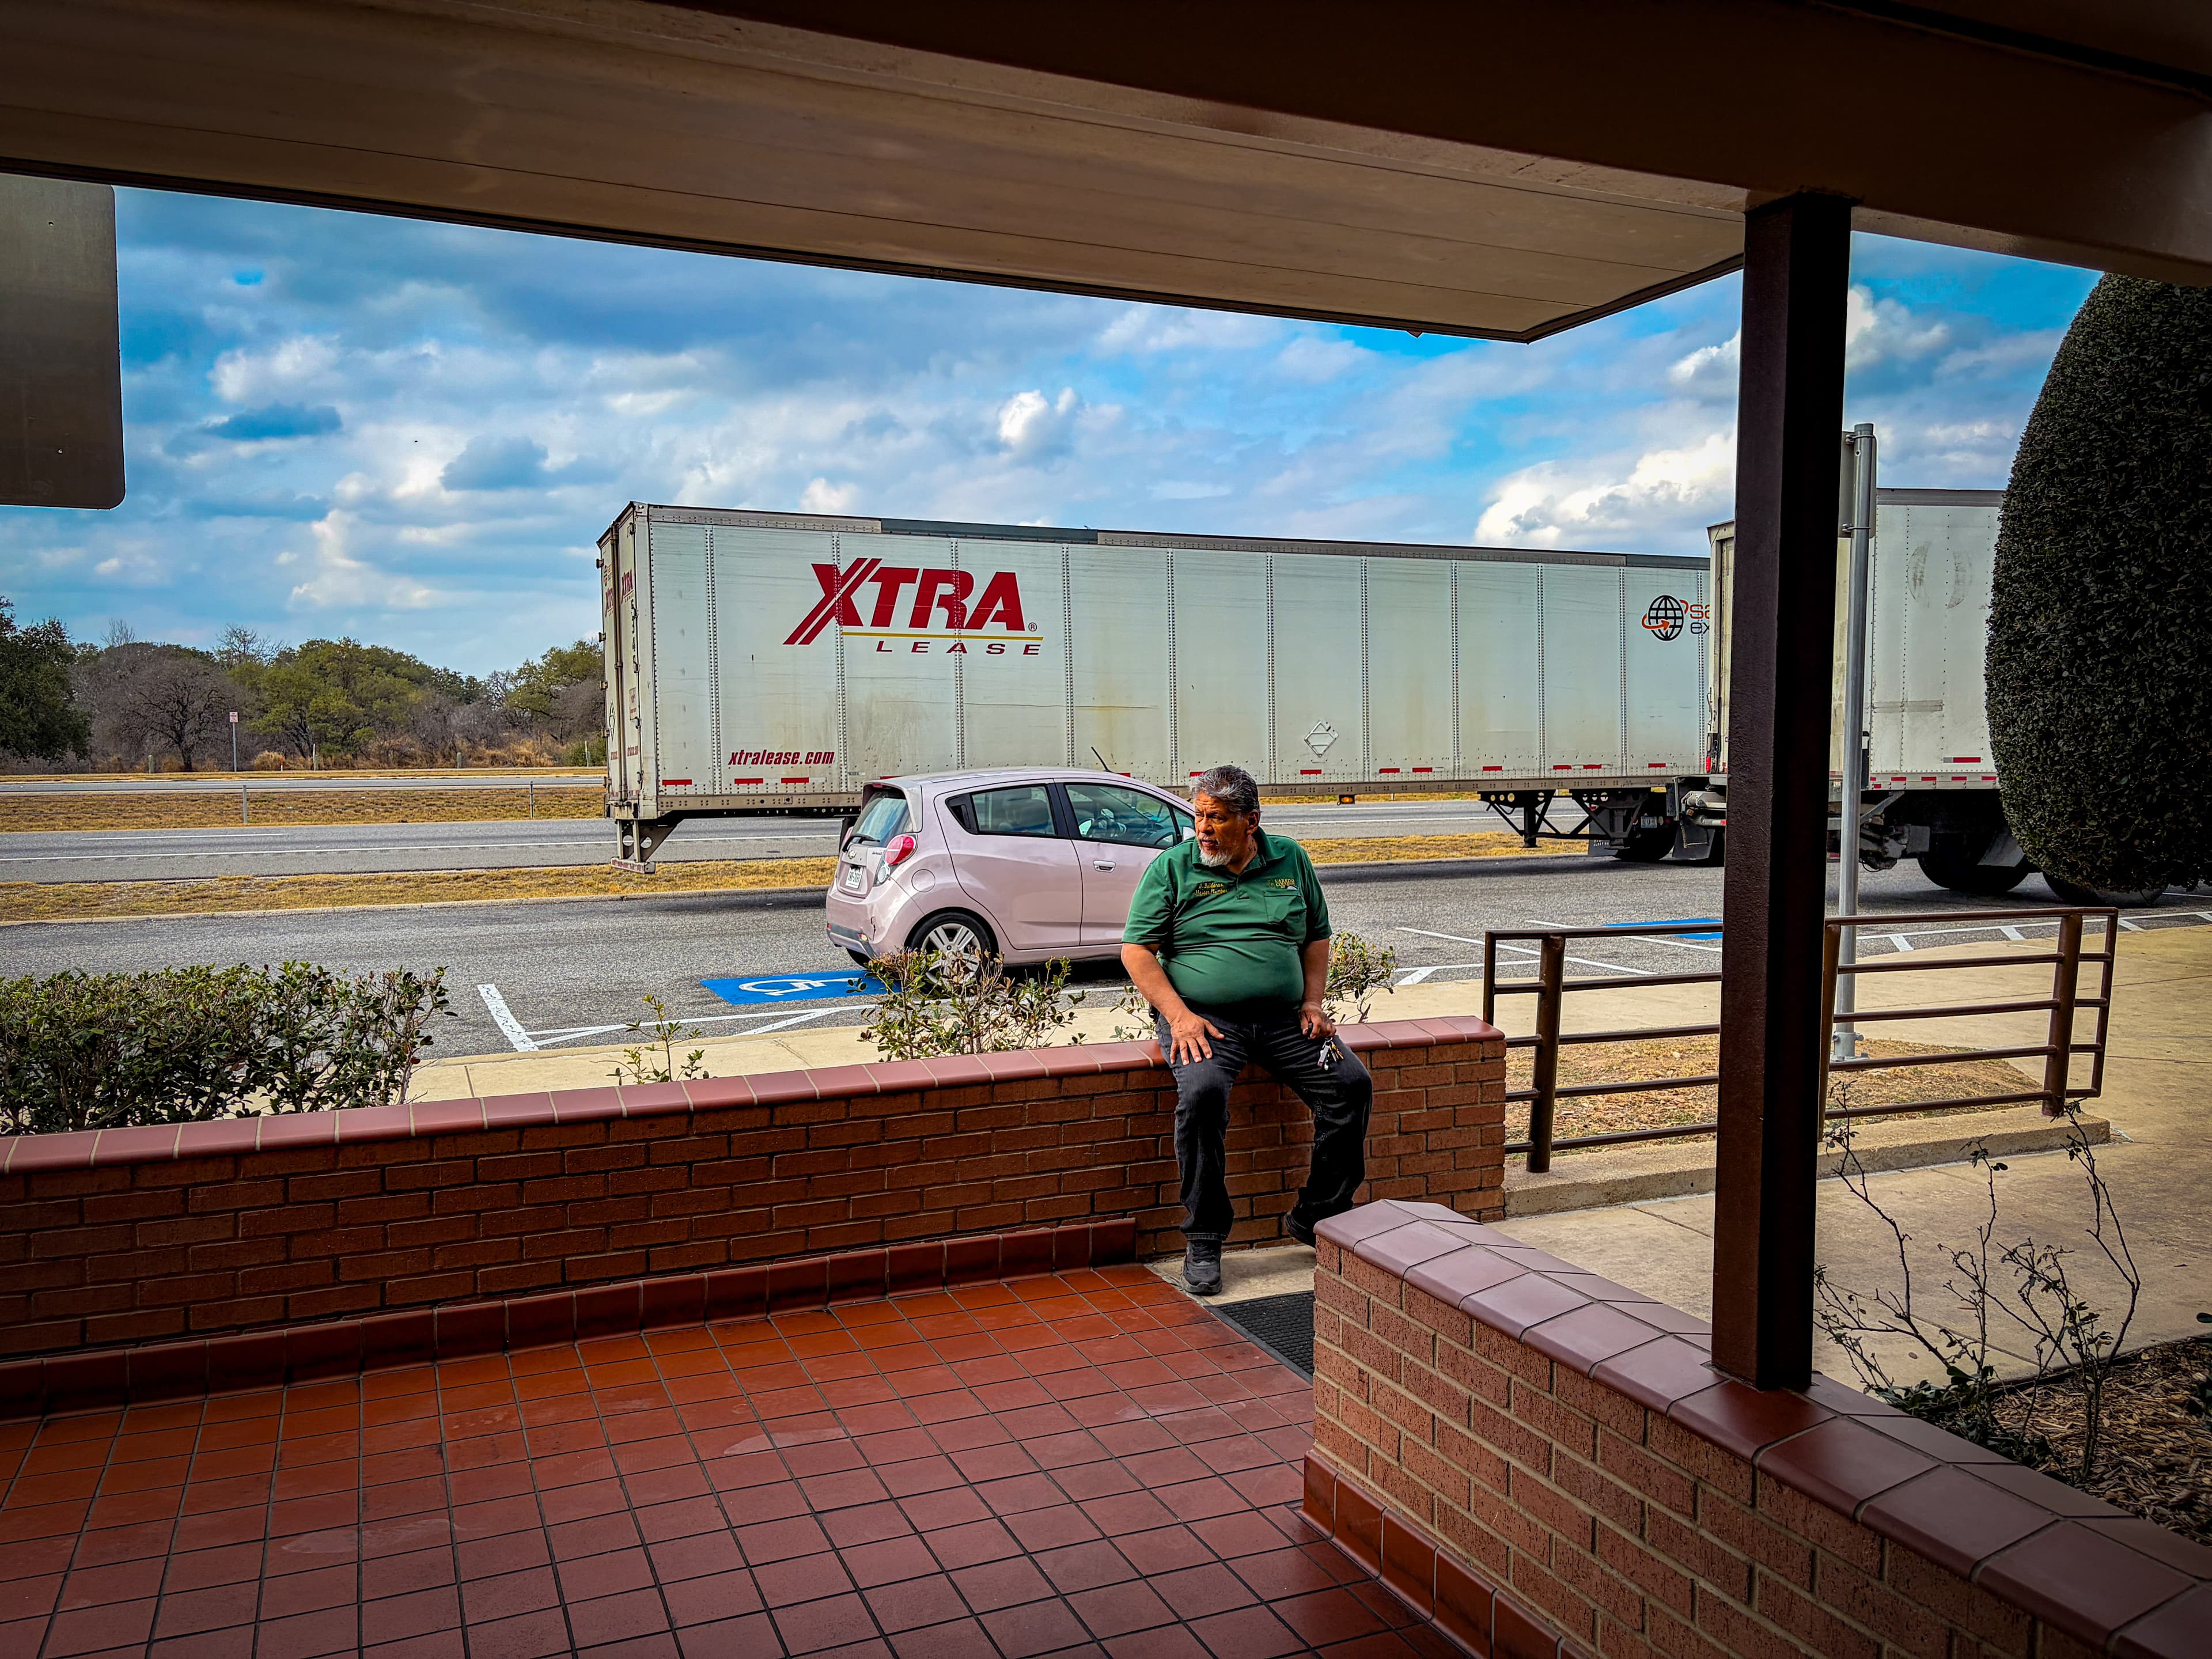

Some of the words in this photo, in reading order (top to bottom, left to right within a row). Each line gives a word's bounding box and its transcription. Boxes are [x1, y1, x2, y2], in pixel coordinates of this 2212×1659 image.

[783, 558, 1025, 645] XTRA
[876, 641, 1041, 656] LEASE
[728, 749, 835, 766] xtralease.com
